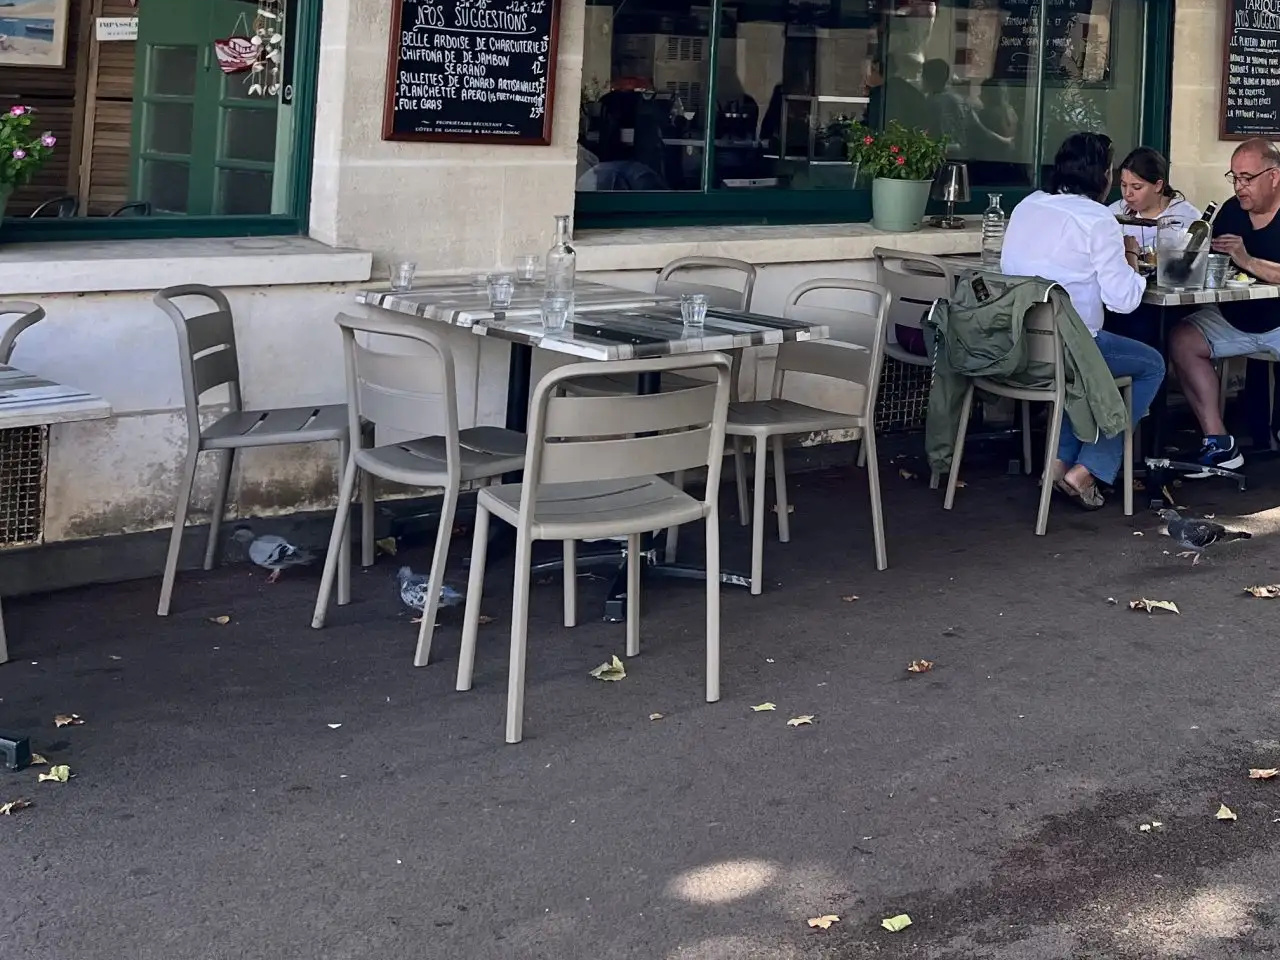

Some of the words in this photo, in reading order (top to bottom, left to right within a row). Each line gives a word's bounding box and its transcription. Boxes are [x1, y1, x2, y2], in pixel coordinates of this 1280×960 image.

[415, 5, 445, 26] NOS
[455, 7, 528, 32] SUGGESTIONS
[401, 31, 430, 47] BELLE
[433, 34, 470, 50] ARDOISE
[475, 36, 487, 50] DE
[489, 37, 540, 53] CHARCUTERIE
[462, 50, 474, 64] DE
[475, 52, 510, 67] JAMBON
[444, 63, 486, 76] SERRANO
[400, 71, 444, 87] RILLETTES
[447, 75, 460, 87] DE
[463, 75, 495, 89] CANARD
[400, 84, 457, 99] PLANCHETTE
[461, 89, 487, 102] APERO
[399, 98, 418, 110] FOIE
[420, 99, 442, 110] GRAS
